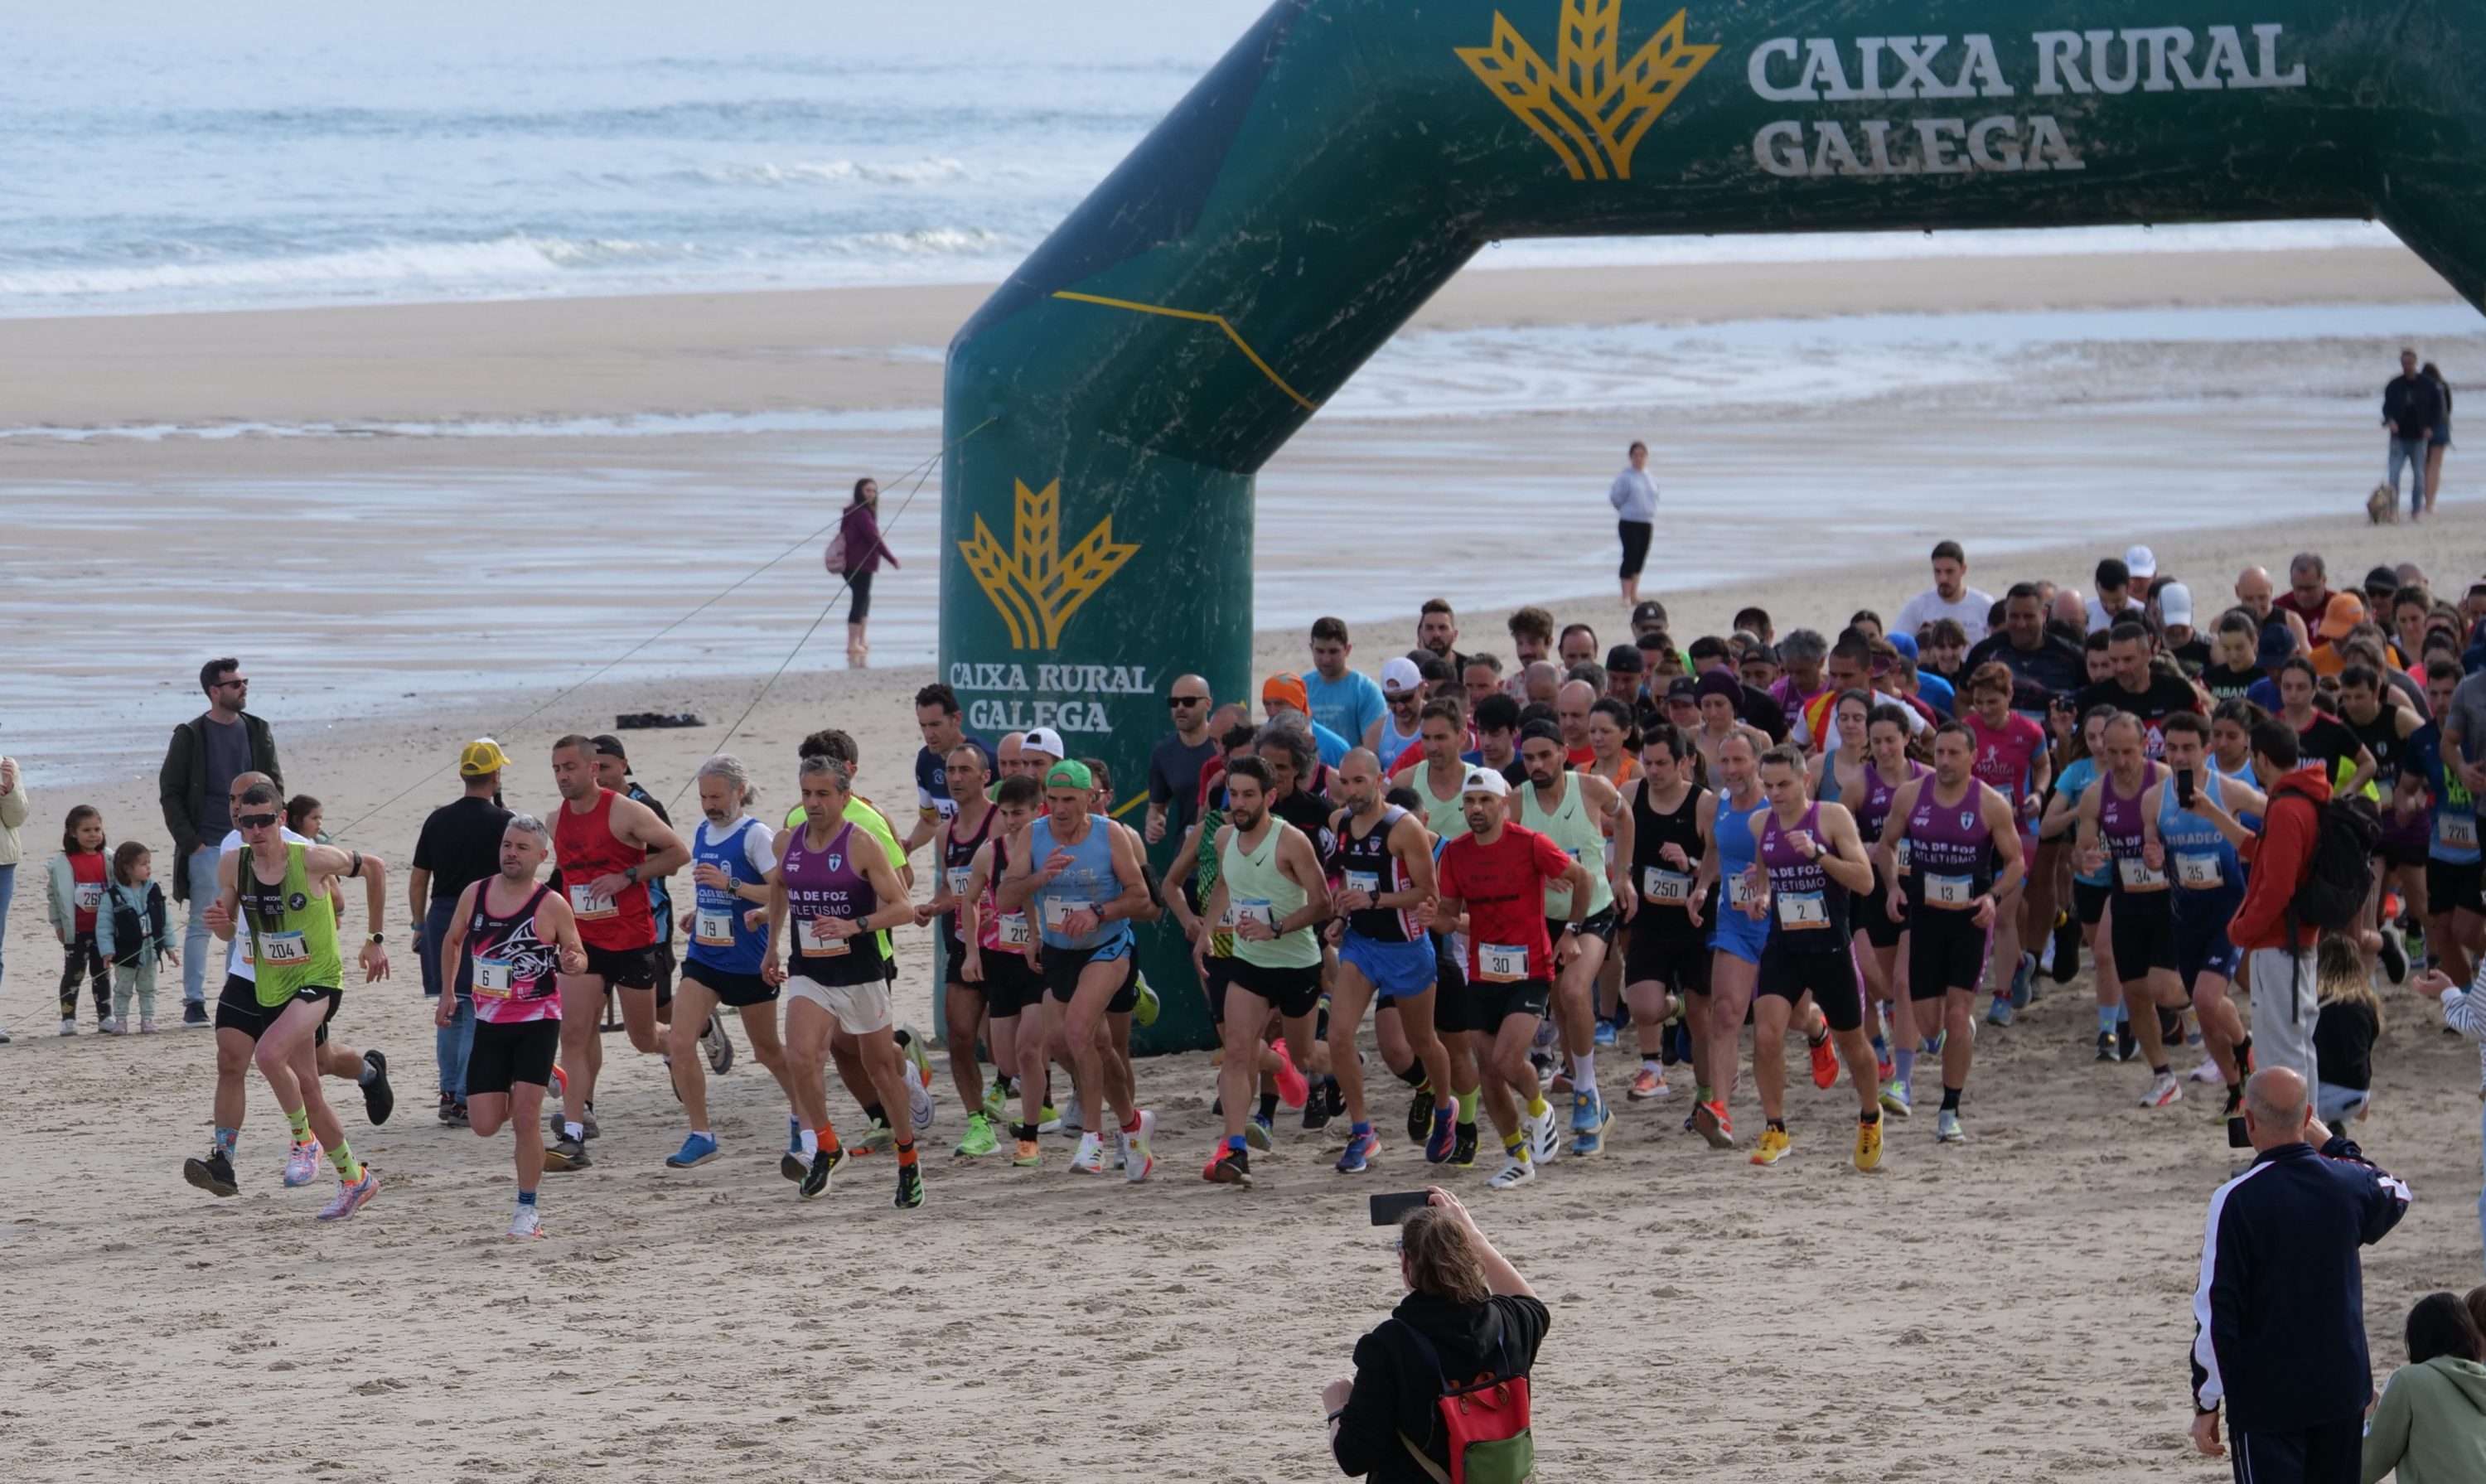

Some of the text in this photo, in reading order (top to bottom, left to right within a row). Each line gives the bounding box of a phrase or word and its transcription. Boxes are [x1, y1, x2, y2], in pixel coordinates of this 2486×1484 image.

[1748, 23, 2307, 102] CAIXA RURAL
[1753, 115, 2086, 177] GALEGA
[950, 662, 1154, 694] CAIXA RURAL
[970, 700, 1113, 732] GALEGA
[1932, 842, 1948, 852] DE
[1779, 867, 1795, 877] DE
[1797, 864, 1823, 877] FOZ
[803, 891, 820, 902] DE
[823, 892, 849, 902] FOZ
[1652, 880, 1678, 897] 250
[1941, 886, 1954, 902] 13
[790, 904, 852, 916] ATLETISMO
[1797, 904, 1807, 920] 2
[704, 921, 716, 937] 79
[268, 943, 295, 959] 204
[1492, 957, 1510, 974] 30
[482, 969, 490, 987] 6
